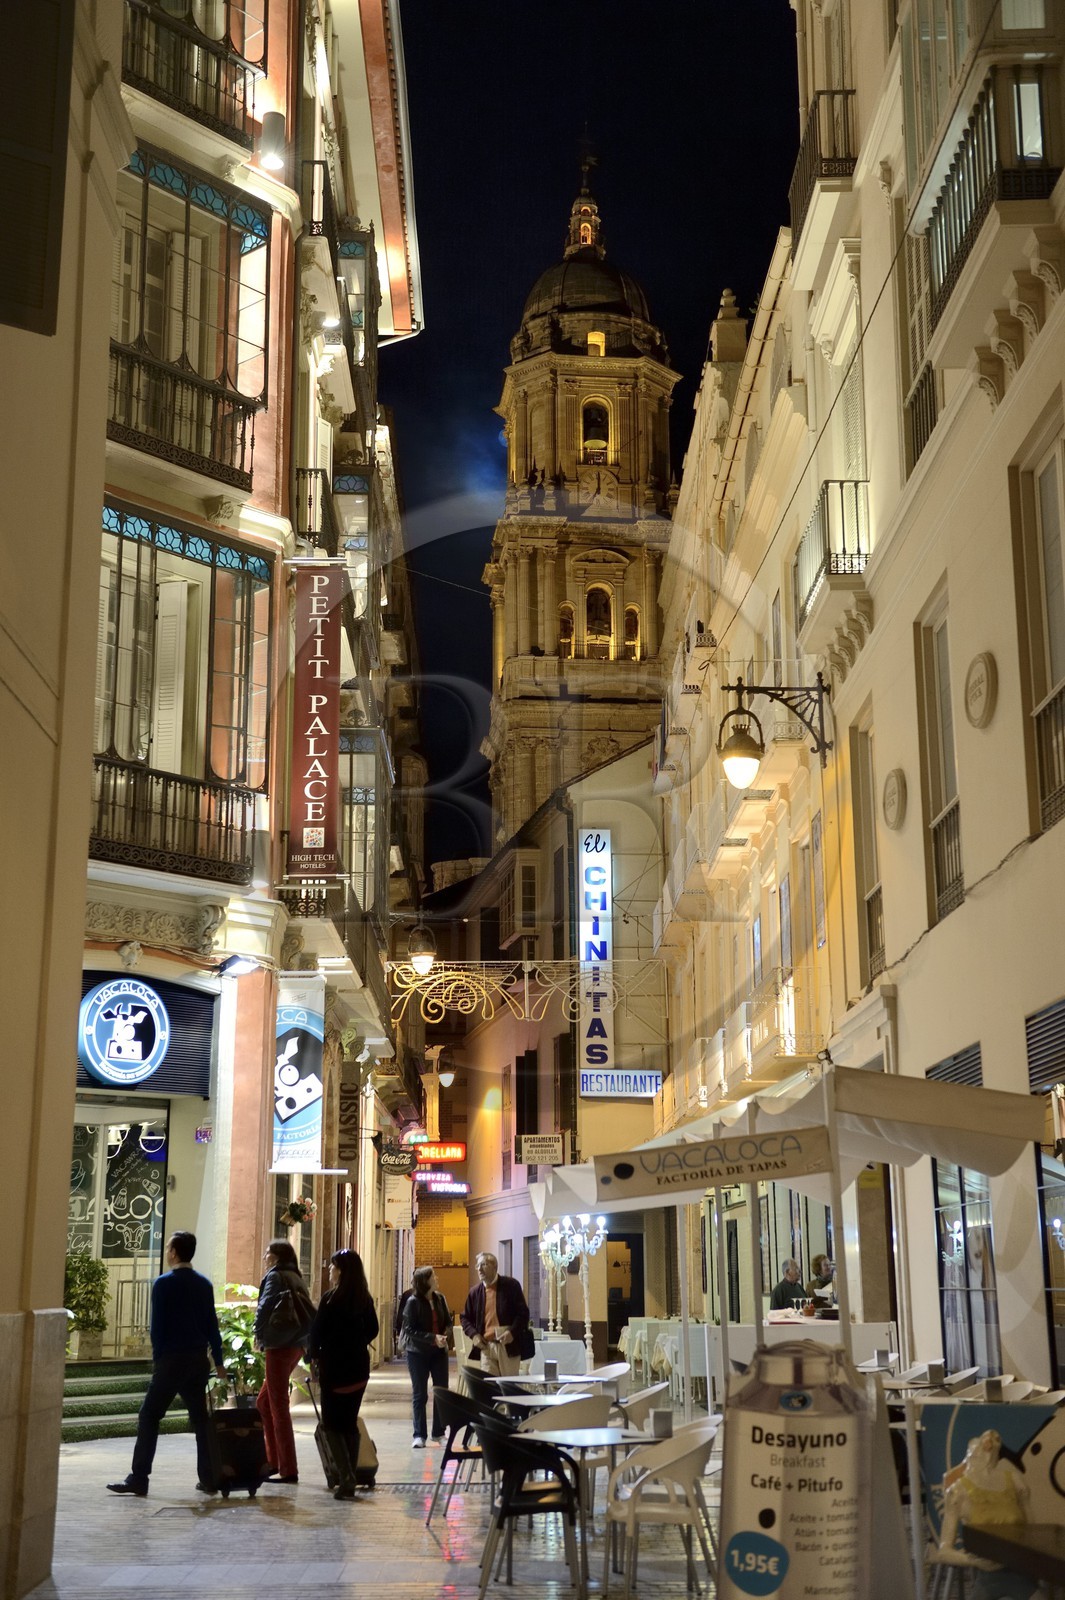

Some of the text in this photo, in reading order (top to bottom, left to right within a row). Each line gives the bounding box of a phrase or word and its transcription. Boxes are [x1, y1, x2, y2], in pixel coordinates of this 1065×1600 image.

[303, 575, 330, 822] PETIT PALACE
[584, 833, 606, 853] El
[291, 853, 335, 862] HIGH TECH
[584, 866, 608, 1065] CHINITAS
[94, 982, 159, 1009] VACALOCA
[581, 1074, 661, 1093] RESTAURANTE
[338, 1082, 359, 1162] CLASSIC
[639, 1135, 802, 1174] VACALOCA
[656, 1160, 787, 1185] FACTORÍA DE TAPAS
[751, 1426, 847, 1453] Desayuno
[769, 1453, 826, 1468] Breakfast
[750, 1473, 843, 1493] Café + Pitufo
[730, 1549, 779, 1576] 1,95€
